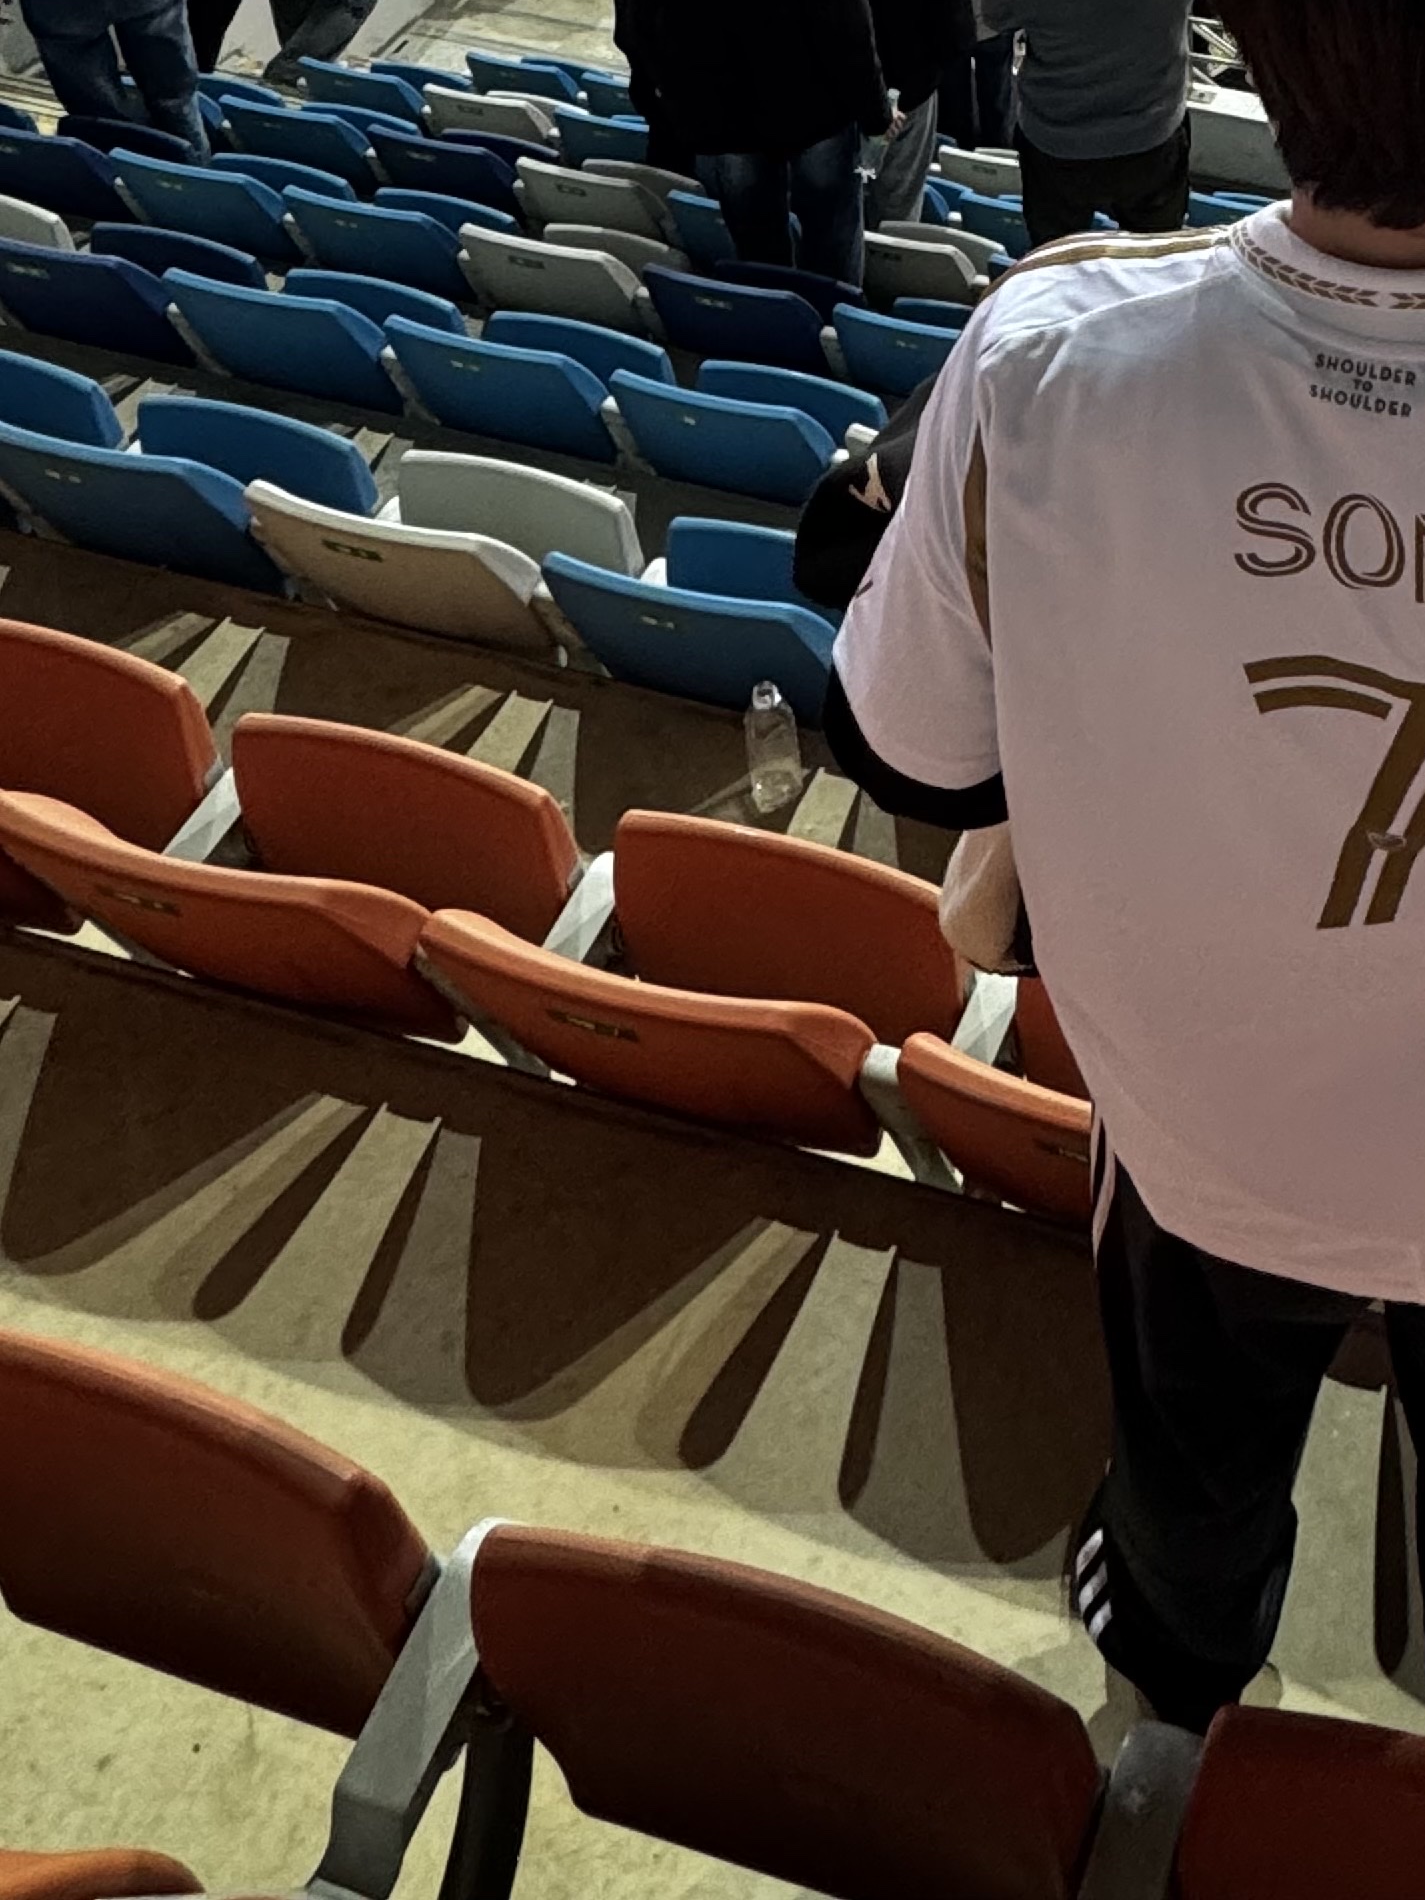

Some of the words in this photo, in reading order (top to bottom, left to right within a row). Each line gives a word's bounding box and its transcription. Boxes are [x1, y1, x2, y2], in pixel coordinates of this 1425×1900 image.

[1314, 352, 1417, 387] SHOULDER
[1353, 378, 1374, 393] TO
[1308, 383, 1412, 418] SHOULDER
